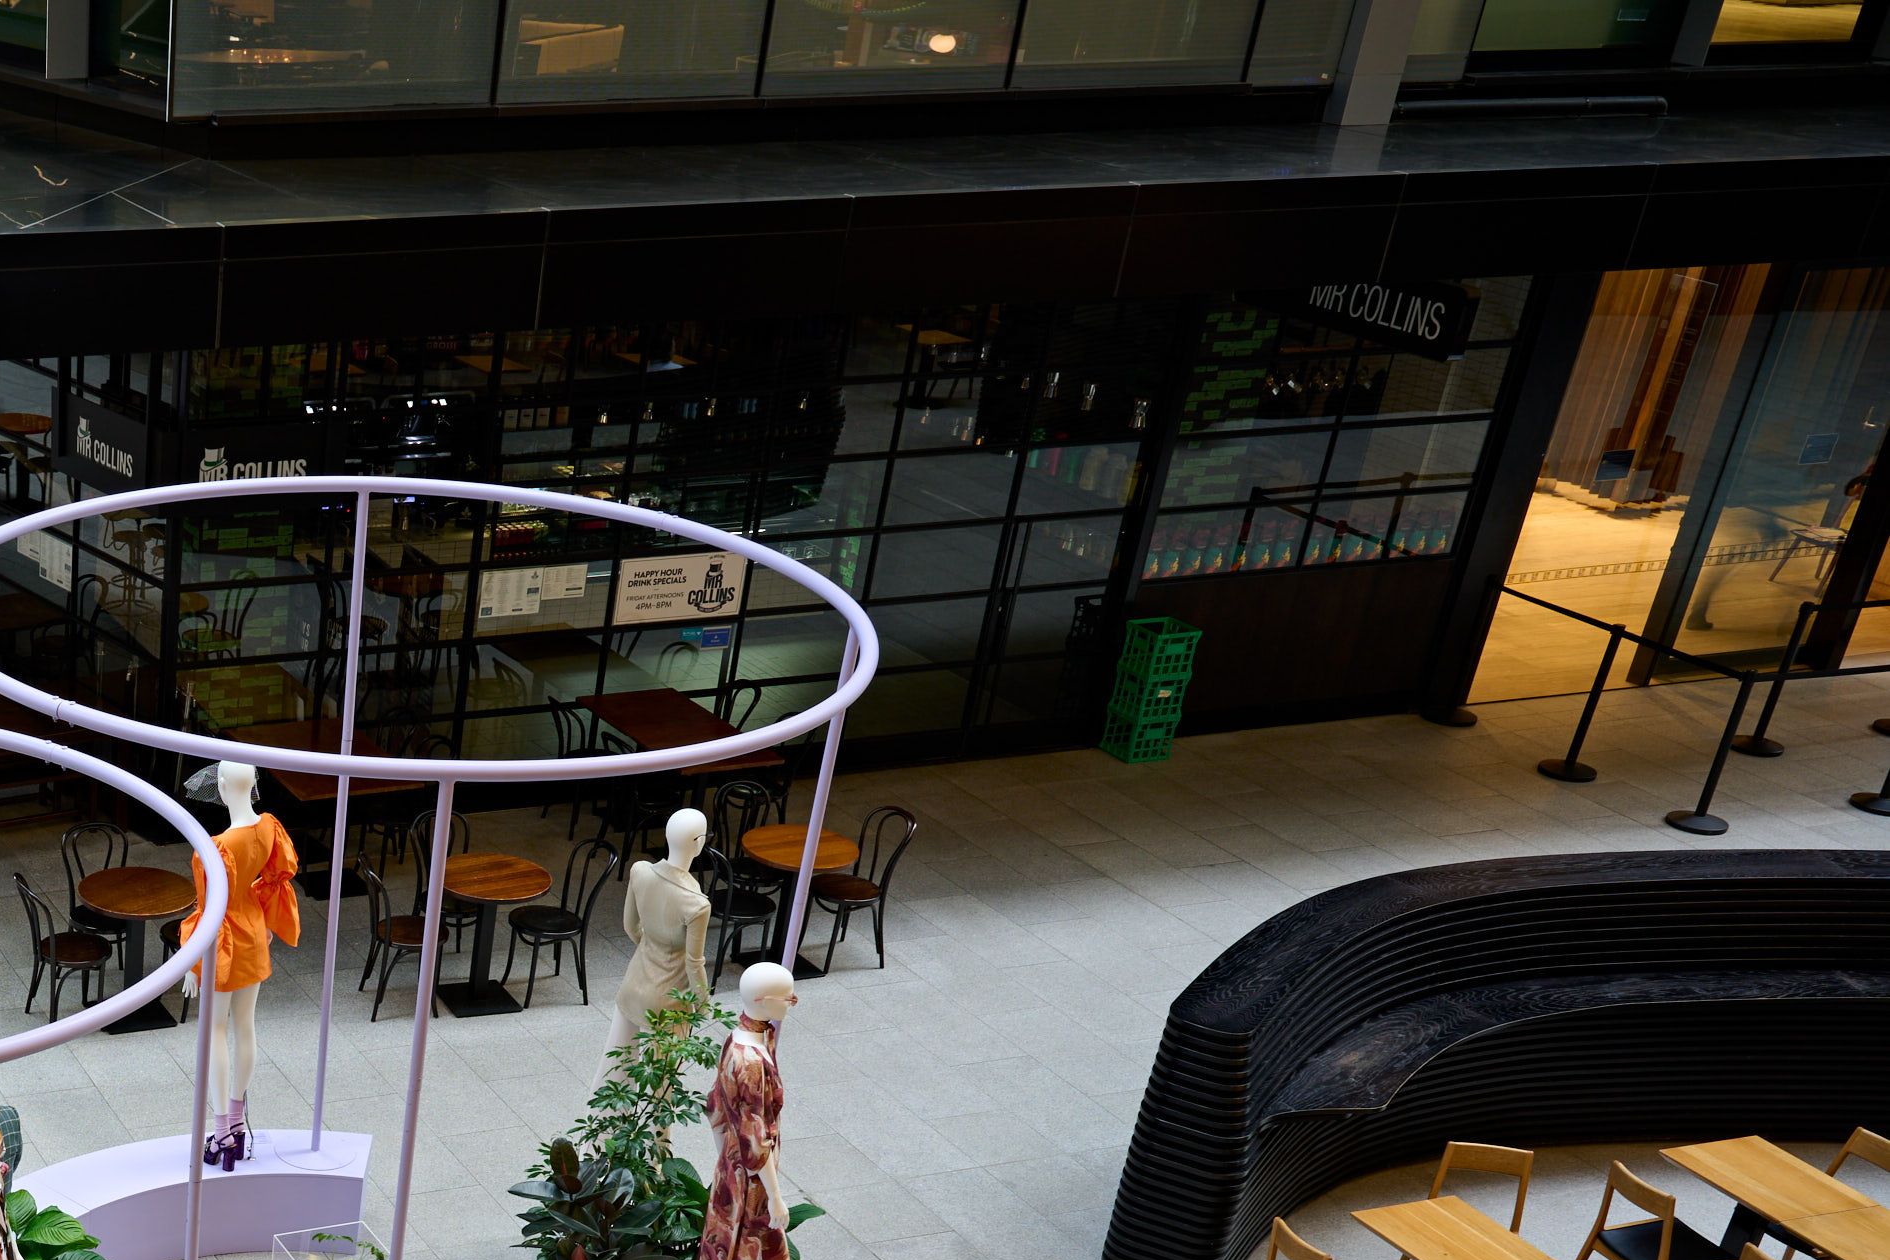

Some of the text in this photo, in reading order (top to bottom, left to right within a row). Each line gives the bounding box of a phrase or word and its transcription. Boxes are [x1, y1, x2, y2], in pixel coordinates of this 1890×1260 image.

[1349, 283, 1445, 340] COLLINS
[76, 435, 134, 478] MR COLLINS
[232, 458, 308, 480] COLLINS
[627, 576, 687, 588] DRINK SPECIALS
[634, 568, 683, 579] HAPPY HOUR
[646, 592, 685, 600] AFTERNOONS
[688, 587, 735, 605] COLLINS
